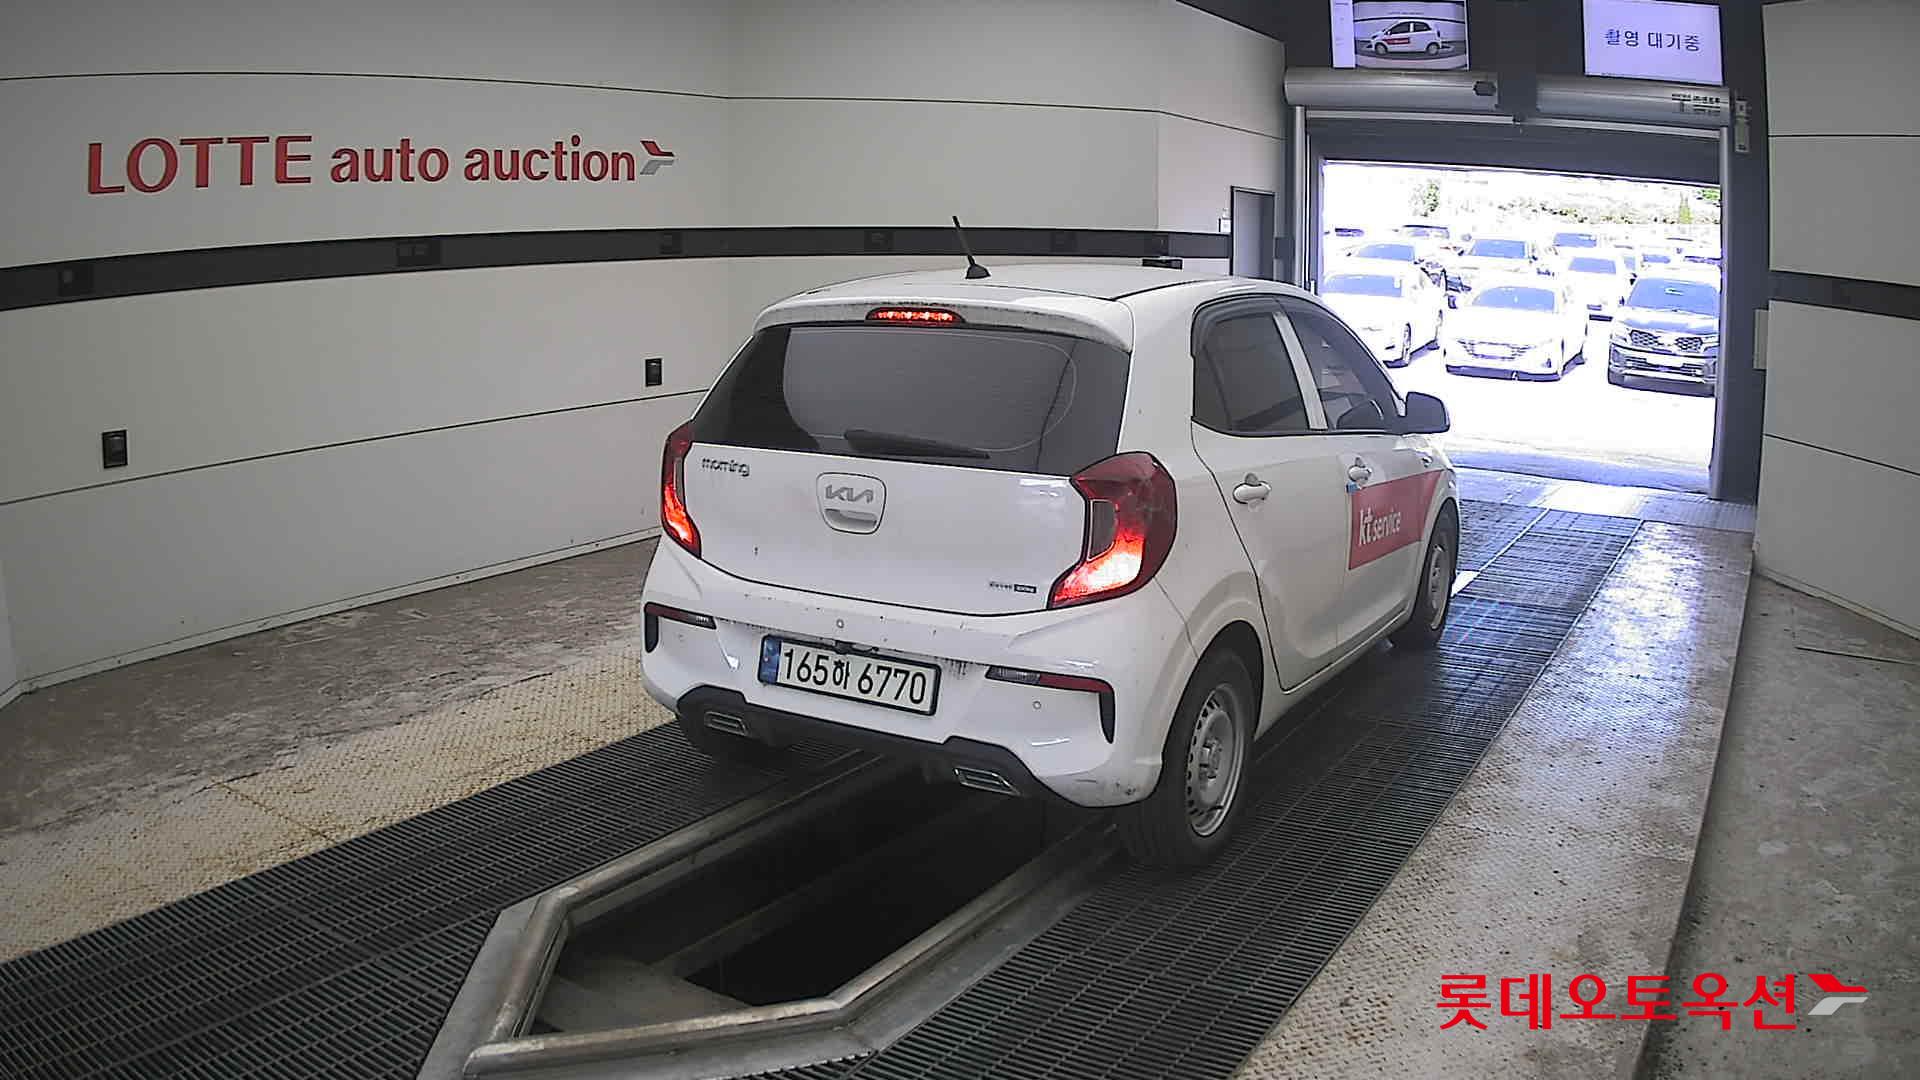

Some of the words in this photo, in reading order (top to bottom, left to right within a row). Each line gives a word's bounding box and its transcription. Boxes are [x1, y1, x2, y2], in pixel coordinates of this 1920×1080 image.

[1647, 32, 1701, 51] 대기중
[87, 135, 312, 194] LOTTE
[330, 138, 449, 182] auto
[463, 135, 635, 181] auction
[701, 458, 750, 477] morning
[825, 484, 874, 503] KIA
[1373, 510, 1401, 541] service
[858, 663, 927, 704] 6770
